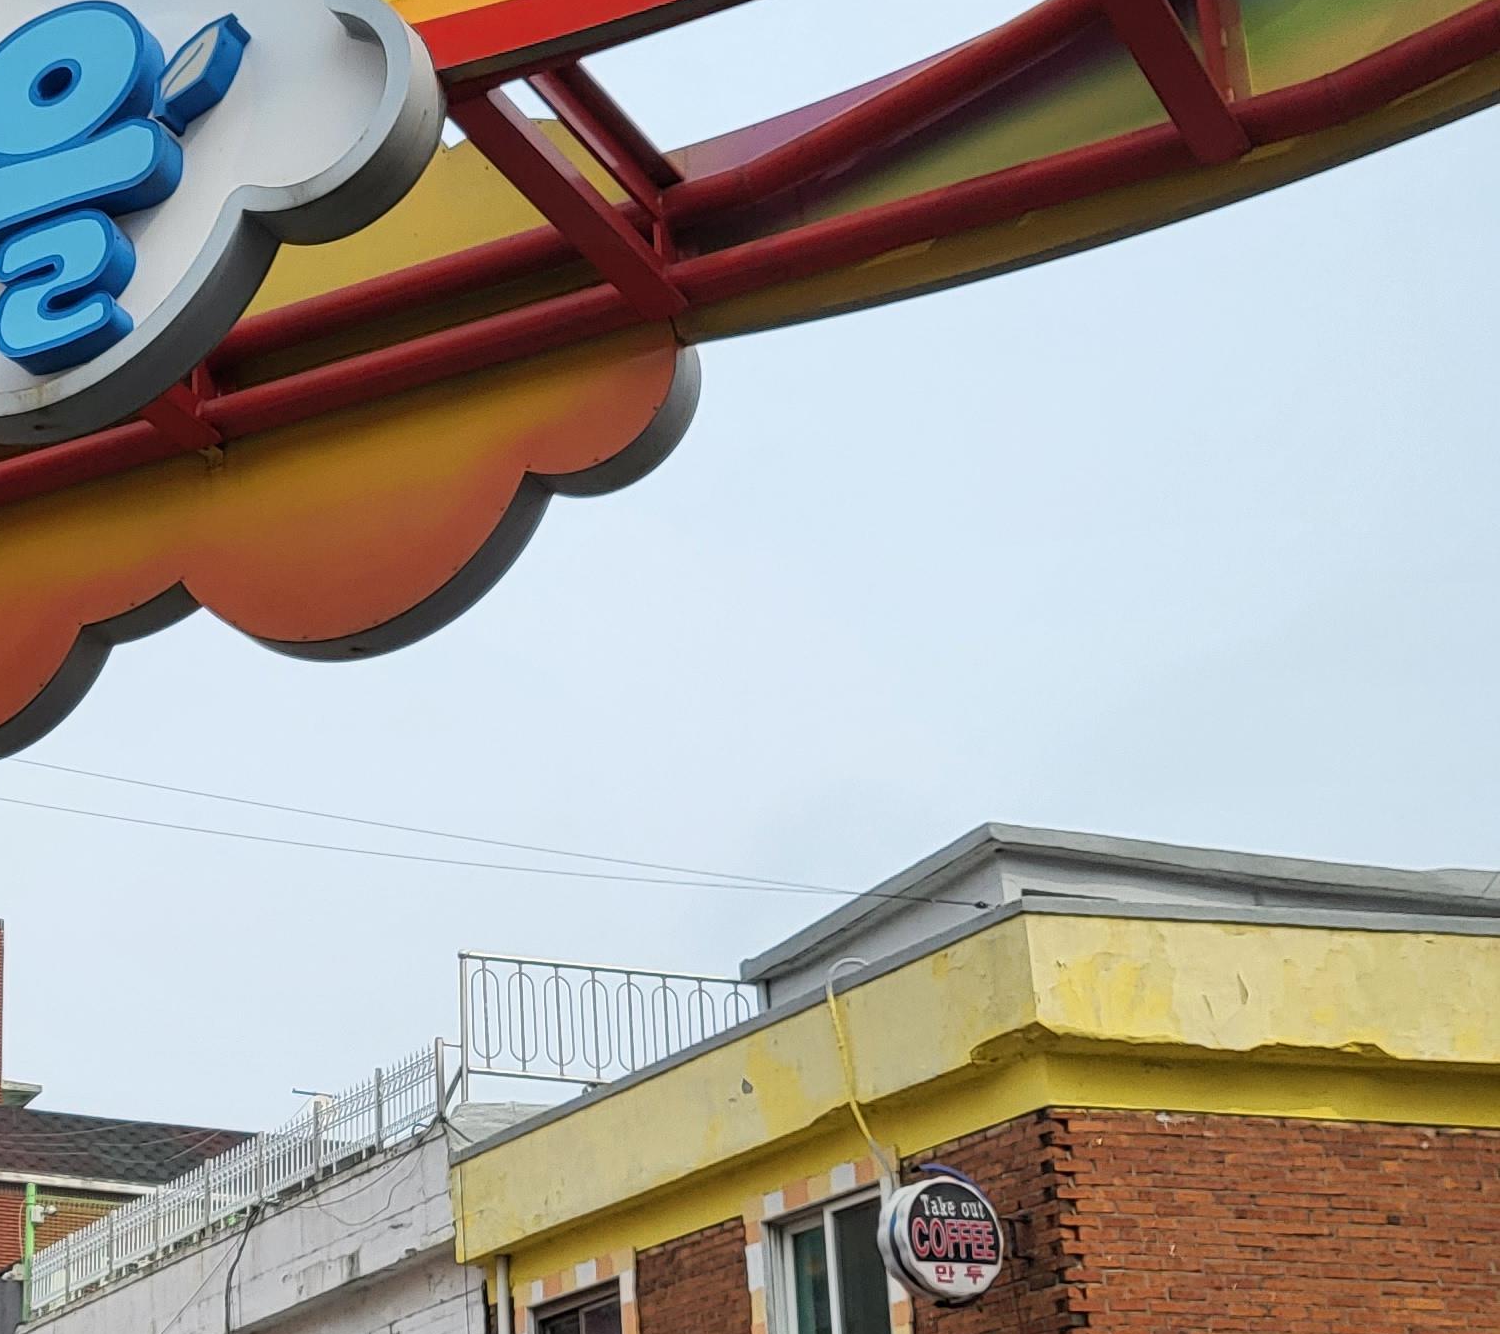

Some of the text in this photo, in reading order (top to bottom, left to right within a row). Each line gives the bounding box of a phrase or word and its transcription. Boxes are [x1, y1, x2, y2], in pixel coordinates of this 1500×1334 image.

[919, 1193, 987, 1220] Take out
[910, 1217, 997, 1261] COFFEE
[934, 1264, 985, 1285] 만두
